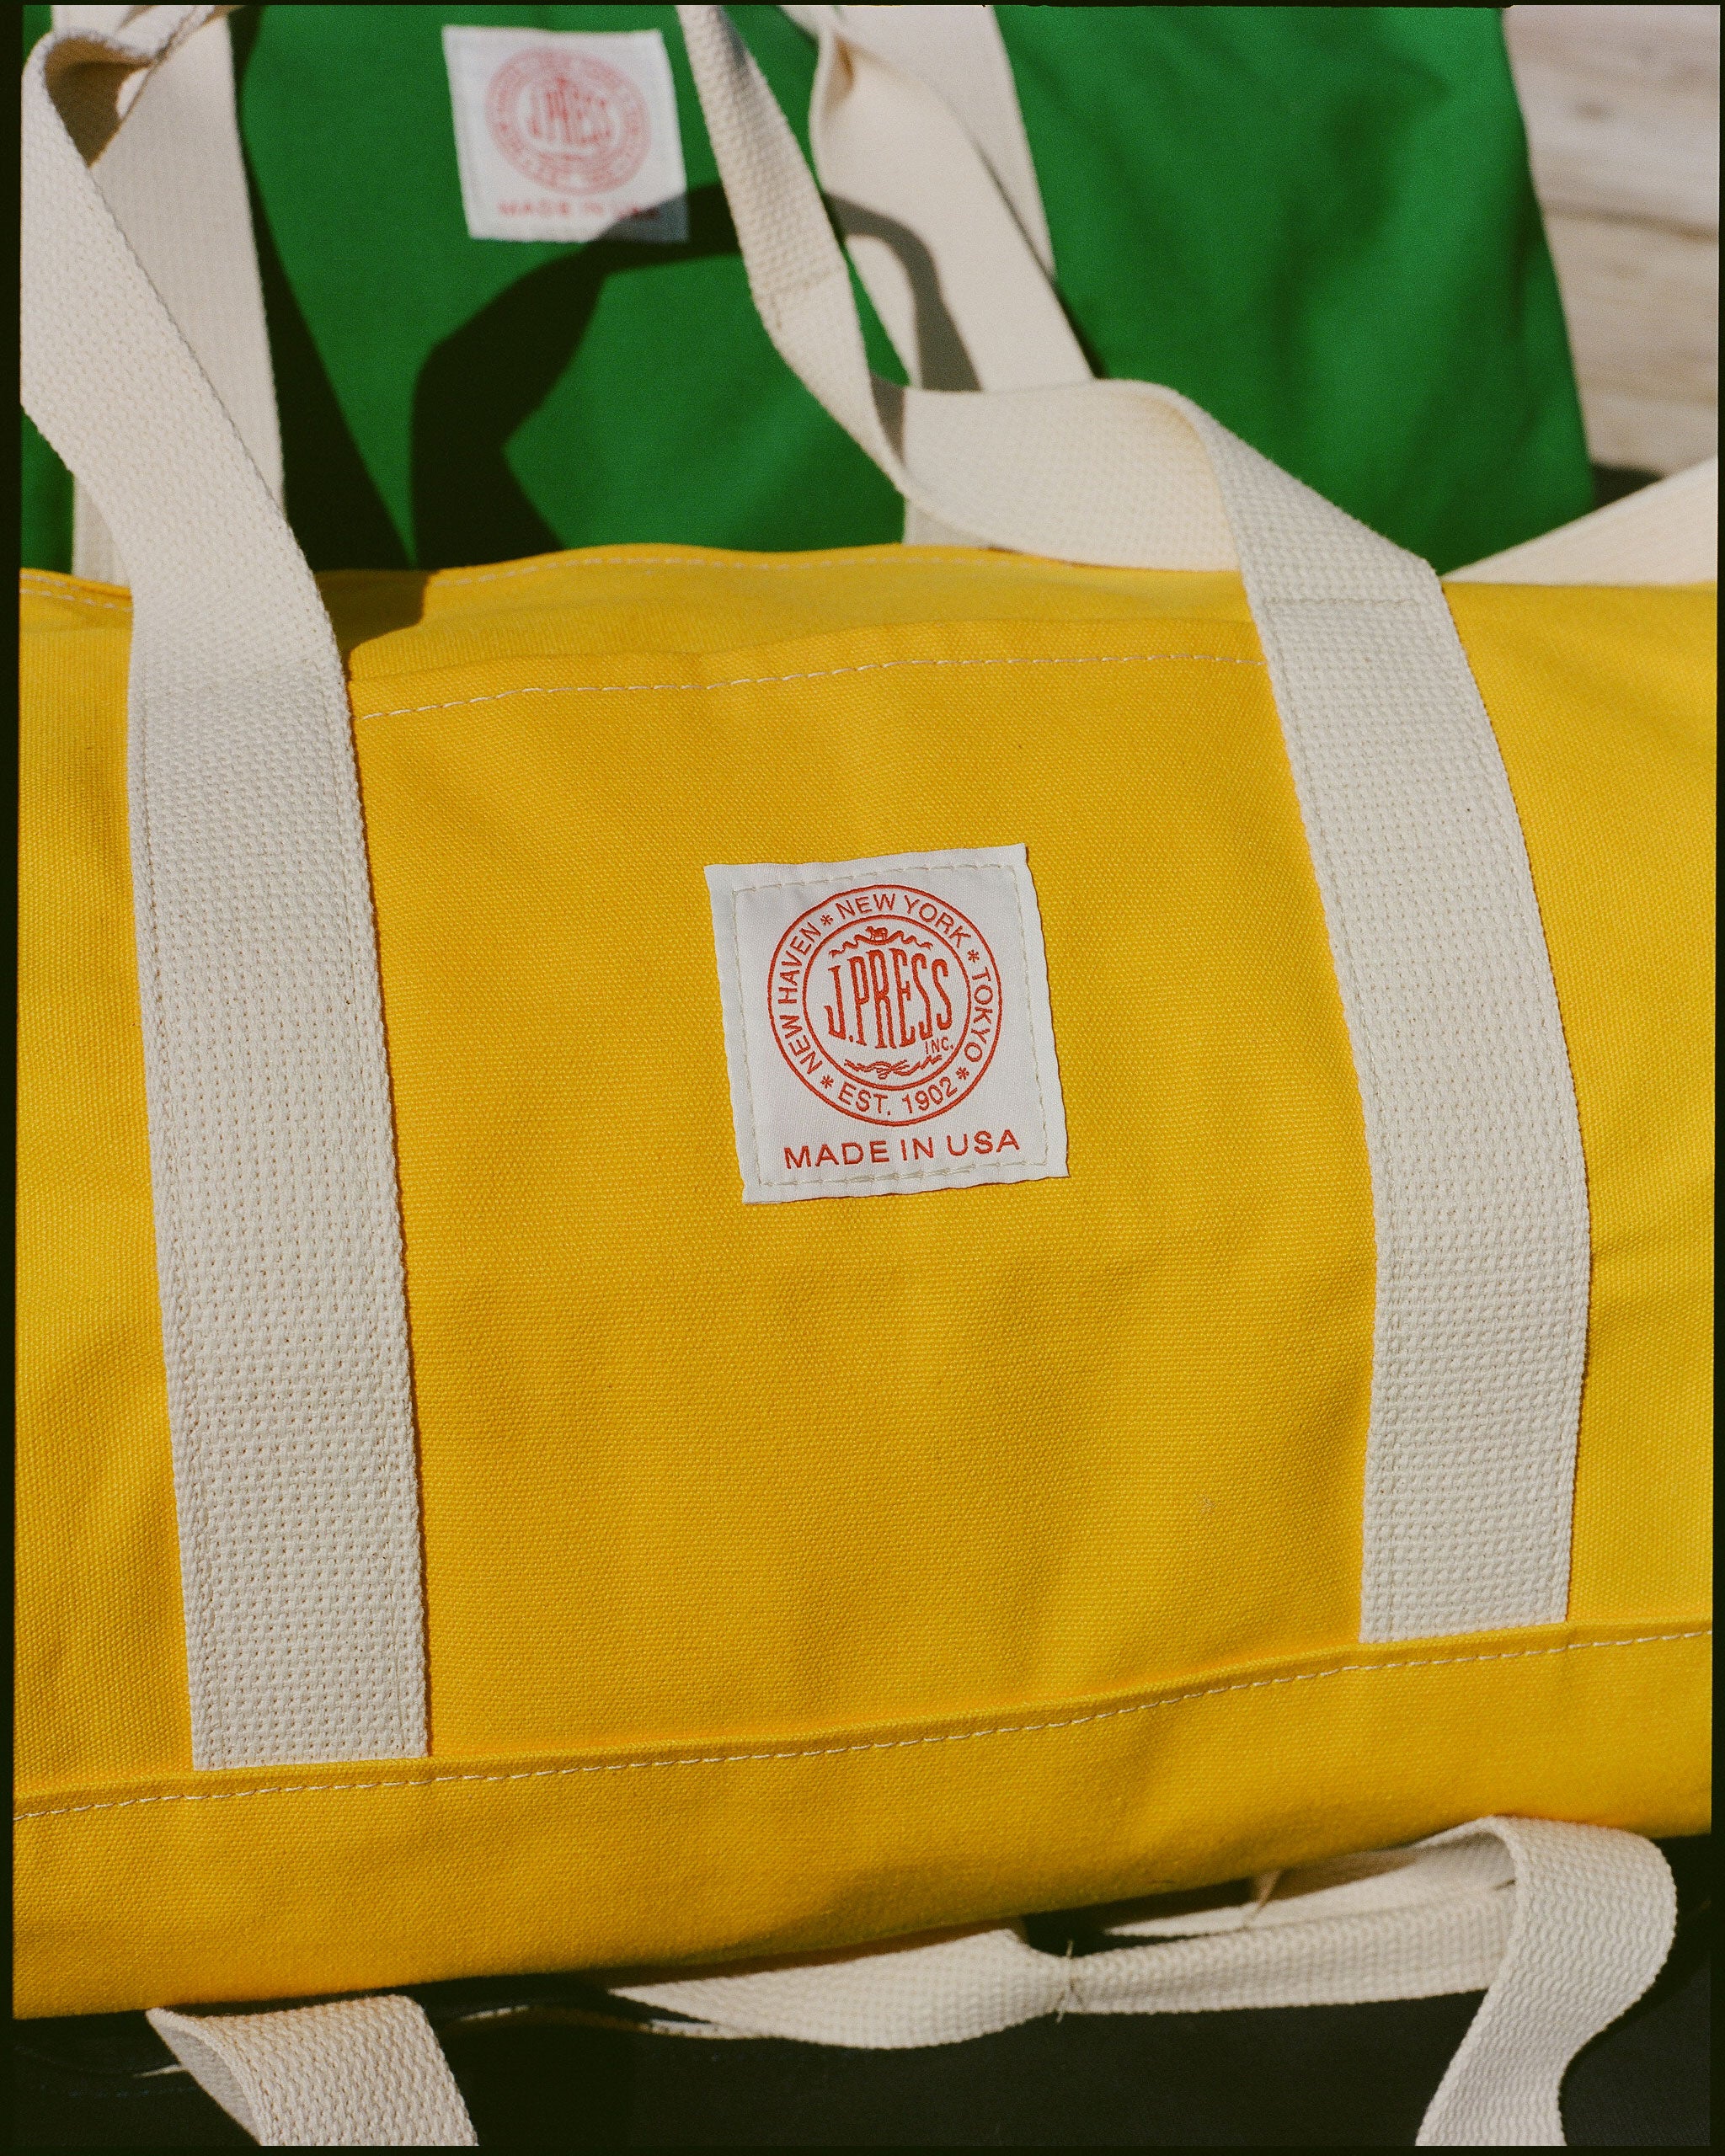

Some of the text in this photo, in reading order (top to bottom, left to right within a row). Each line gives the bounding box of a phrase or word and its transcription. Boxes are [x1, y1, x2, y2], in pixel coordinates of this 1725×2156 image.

[835, 894, 971, 948] NEW YORK
[777, 922, 823, 1075] NEW HAVEN
[824, 947, 953, 1049] J.PRESS
[963, 968, 994, 1063] TOKYO
[925, 1036, 954, 1054] INC.
[838, 1076, 958, 1116] EST. 1902
[783, 1129, 1020, 1169] MADE IN USA
